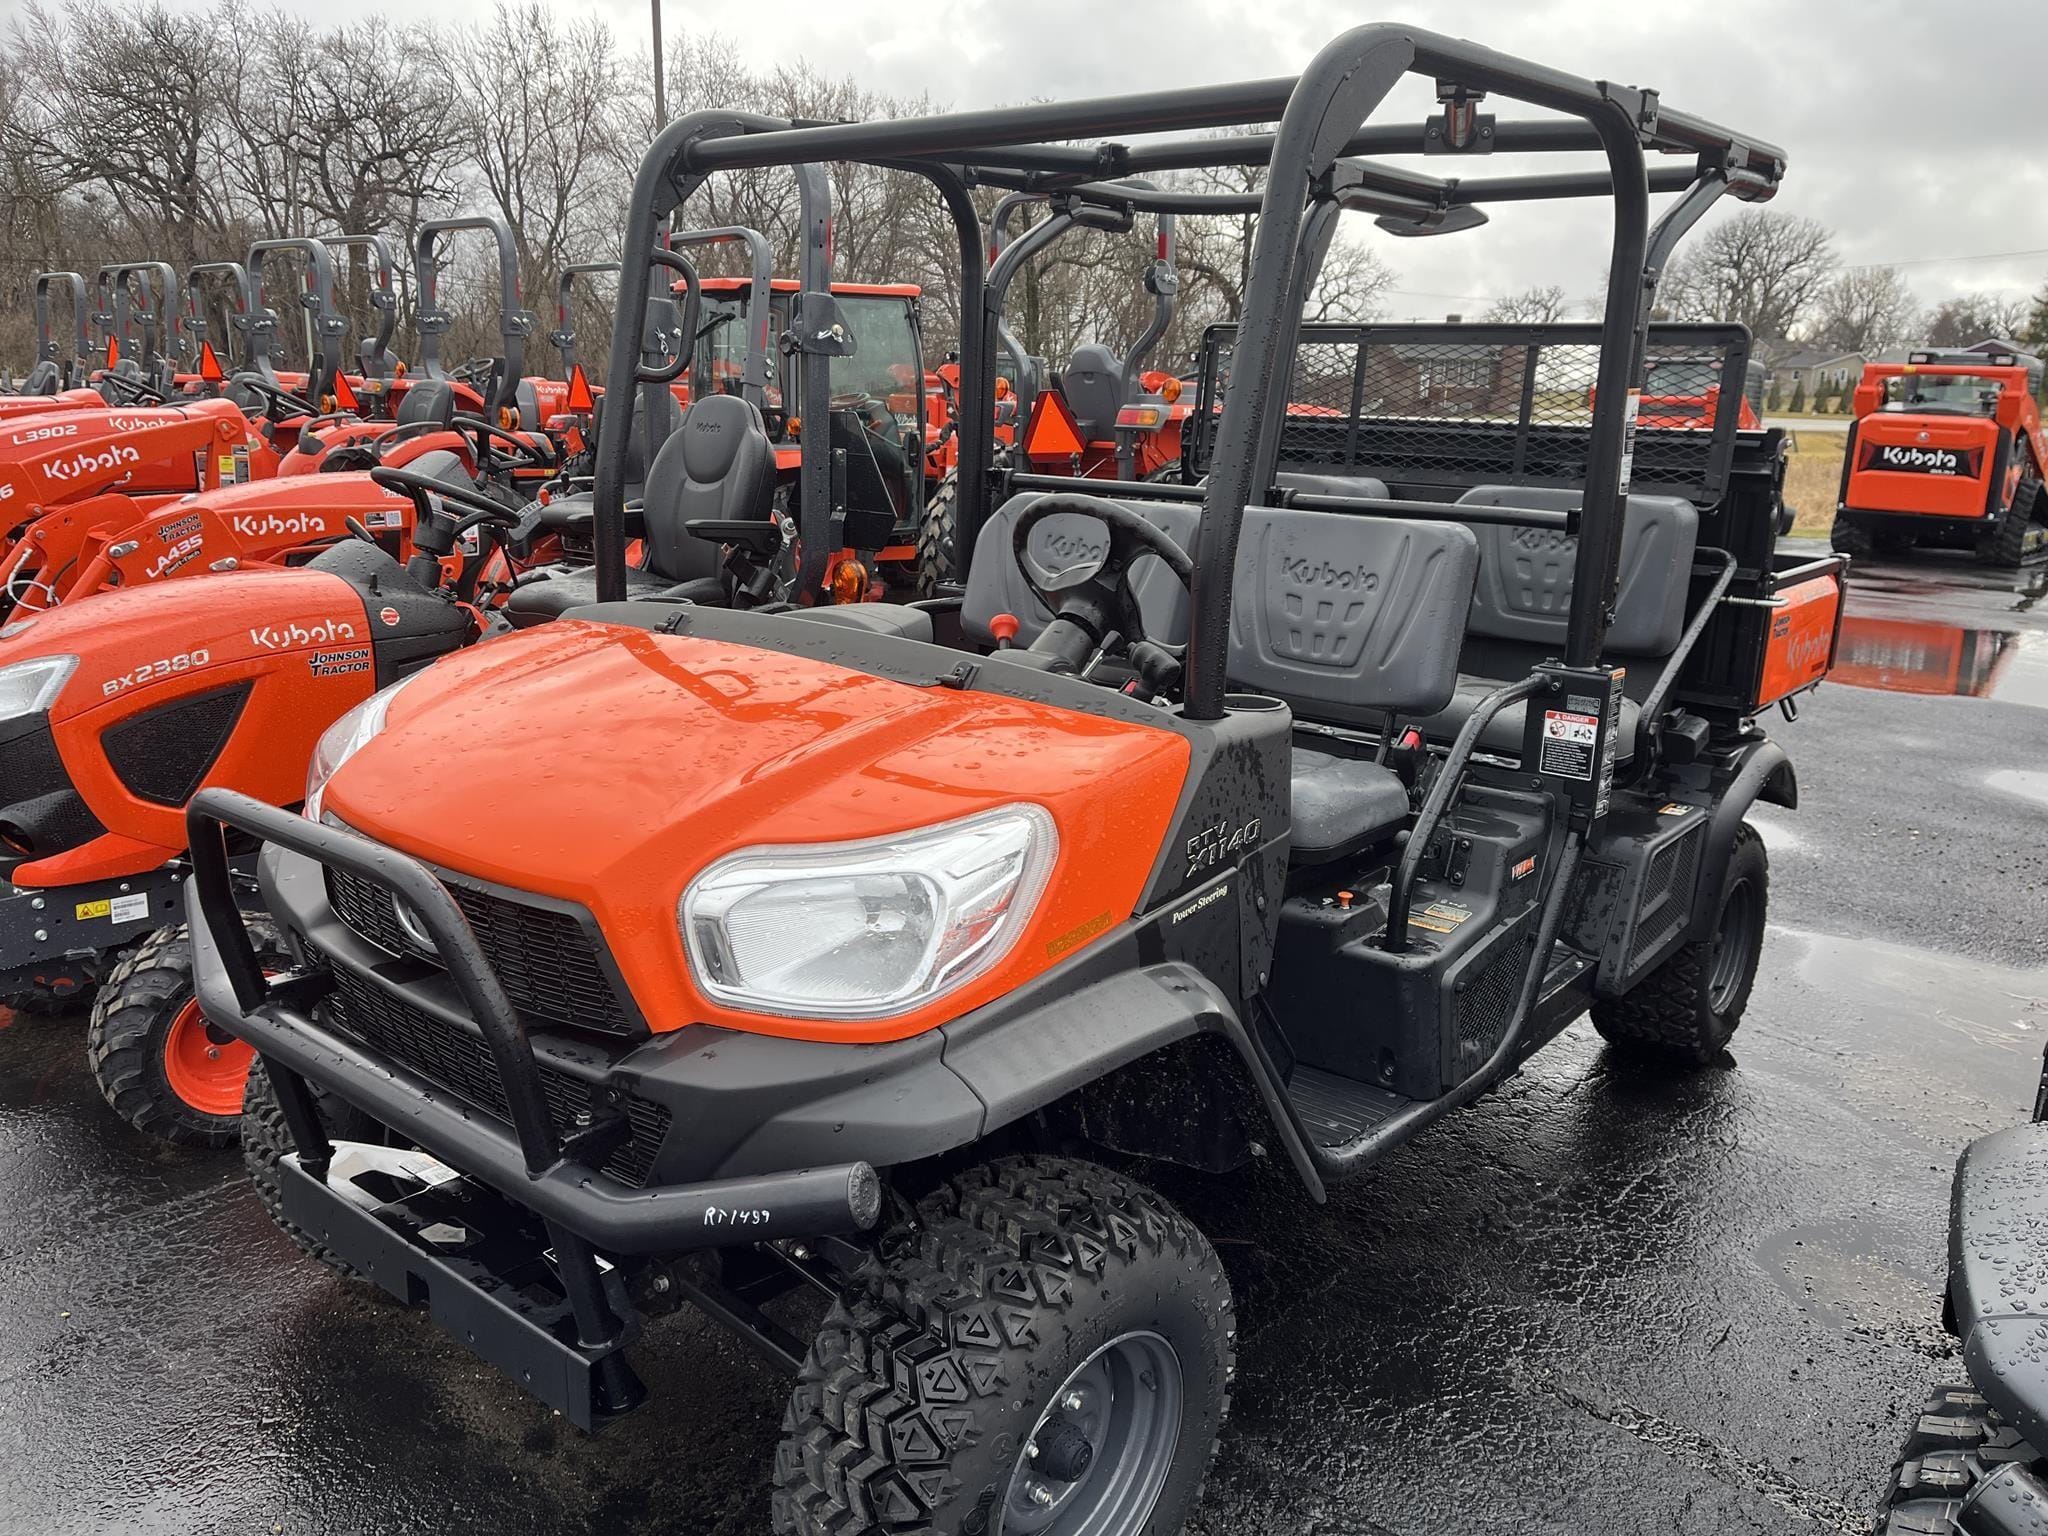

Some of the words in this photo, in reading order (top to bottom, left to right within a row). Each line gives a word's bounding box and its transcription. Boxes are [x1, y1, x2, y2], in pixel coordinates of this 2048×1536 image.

[12, 424, 78, 446] L3902
[43, 445, 140, 480] Kubota
[1883, 446, 1957, 467] Kubota
[158, 513, 199, 536] JOHNSON
[161, 522, 203, 543] TRACTOR
[233, 512, 326, 536] Kubota
[1512, 527, 1578, 554] Kubo
[145, 533, 204, 578] LA435
[1281, 556, 1380, 593] Kubota
[250, 619, 355, 649] Kubota
[308, 649, 370, 665] JOHNSON
[311, 661, 371, 677] TRACTOR
[102, 649, 209, 697] BX2380
[1562, 714, 1590, 724] DANGER
[1187, 820, 1227, 854] RTV
[1187, 818, 1261, 878] X1140
[1173, 902, 1198, 924] Power
[1197, 885, 1228, 910] Steering
